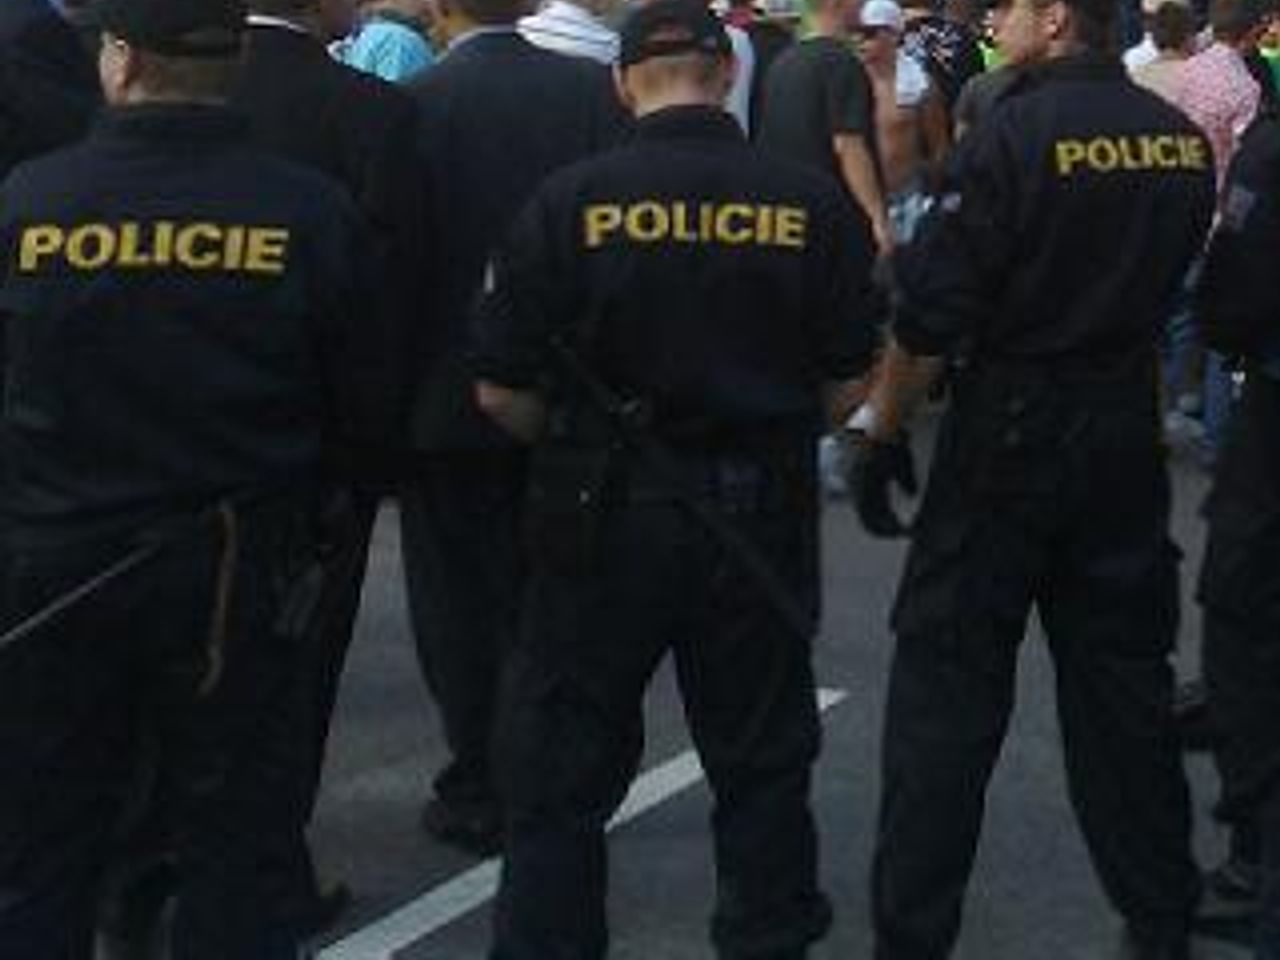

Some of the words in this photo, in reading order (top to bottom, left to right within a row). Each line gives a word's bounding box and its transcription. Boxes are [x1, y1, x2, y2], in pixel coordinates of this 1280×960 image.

[1054, 135, 1206, 175] POLICIE
[17, 220, 291, 272] POLICIE
[583, 200, 807, 247] POLICIE
